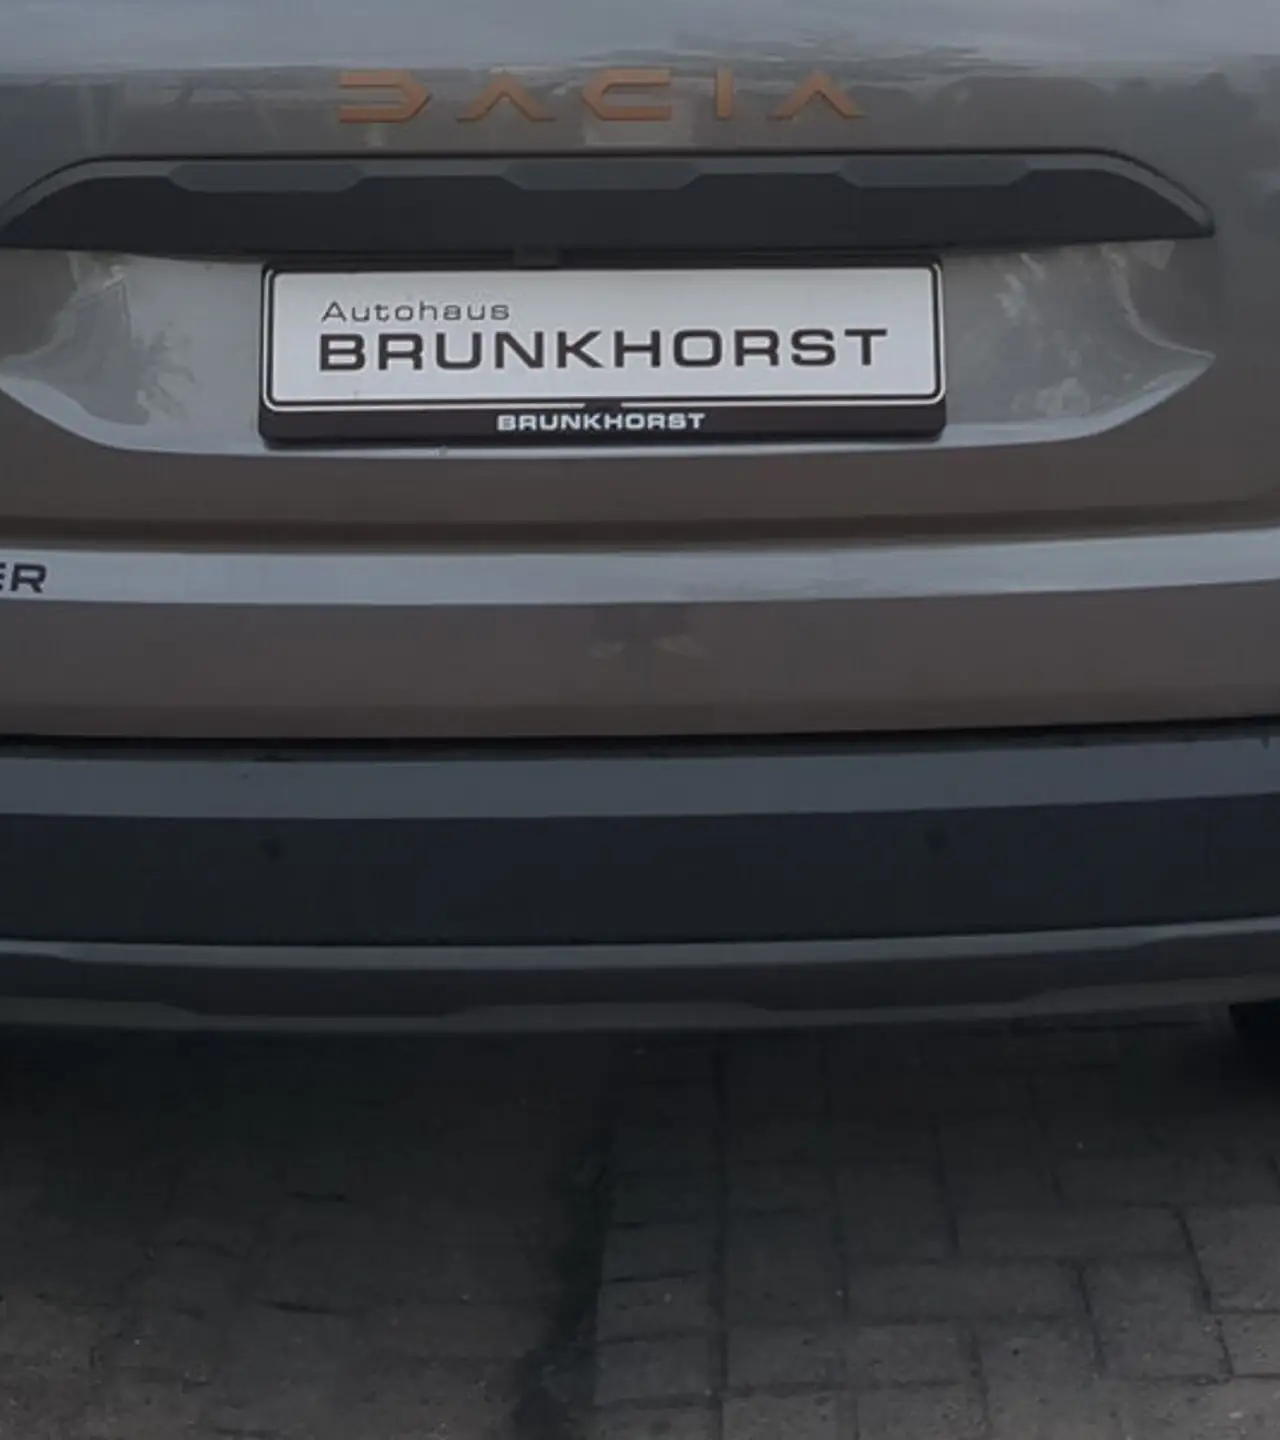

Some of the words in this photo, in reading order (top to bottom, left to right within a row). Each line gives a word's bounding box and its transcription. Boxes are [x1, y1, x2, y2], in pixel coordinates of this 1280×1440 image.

[337, 67, 866, 123] DACIA
[322, 301, 511, 322] Autohaus
[320, 328, 888, 371] BRUNKHORST
[497, 413, 706, 432] BRUNKHORST
